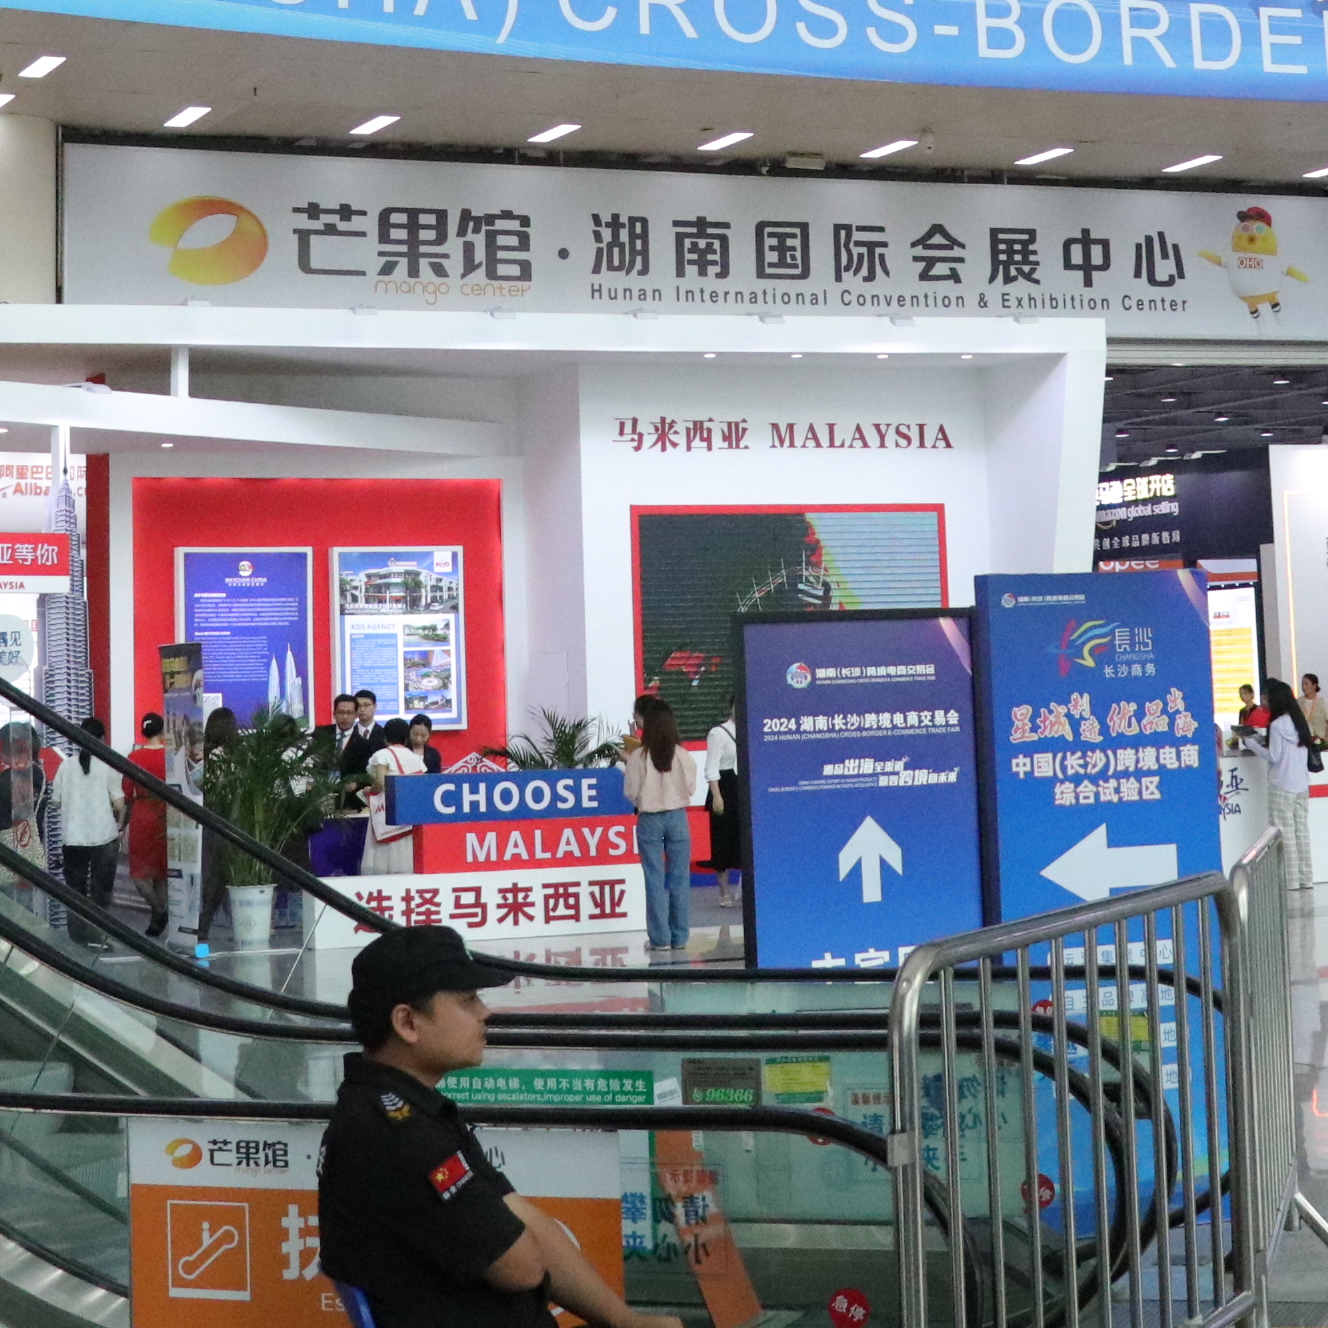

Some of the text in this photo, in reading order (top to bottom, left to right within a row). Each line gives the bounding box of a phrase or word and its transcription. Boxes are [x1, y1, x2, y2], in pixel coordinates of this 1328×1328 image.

[373, 279, 532, 306] mango center
[590, 283, 1188, 313] Hunan International Convention & Exhibition Center
[612, 415, 955, 454] 马来西亚 MALAYSIA
[1115, 651, 1155, 661] CHANGSHA
[1103, 662, 1157, 678] 长沙商务
[762, 717, 797, 733] 2024
[763, 734, 778, 742] 2024
[779, 733, 801, 741] HUNAN
[840, 730, 888, 739] CROSS-BORDER
[888, 728, 927, 736] E-COMMERCE
[928, 727, 947, 735] TRADE
[1011, 743, 1200, 779] 中国(长沙)跨境电商
[432, 777, 599, 815] CHOOSE
[1053, 775, 1161, 806] 综合试验区
[353, 877, 628, 936] 选择马来西亚
[441, 1090, 469, 1102] orrect
[471, 1092, 496, 1104] using
[585, 1093, 602, 1103] use
[604, 1092, 612, 1103] of
[614, 1092, 647, 1105] danger
[705, 1087, 754, 1103] 96366
[831, 1294, 867, 1322] 急停
